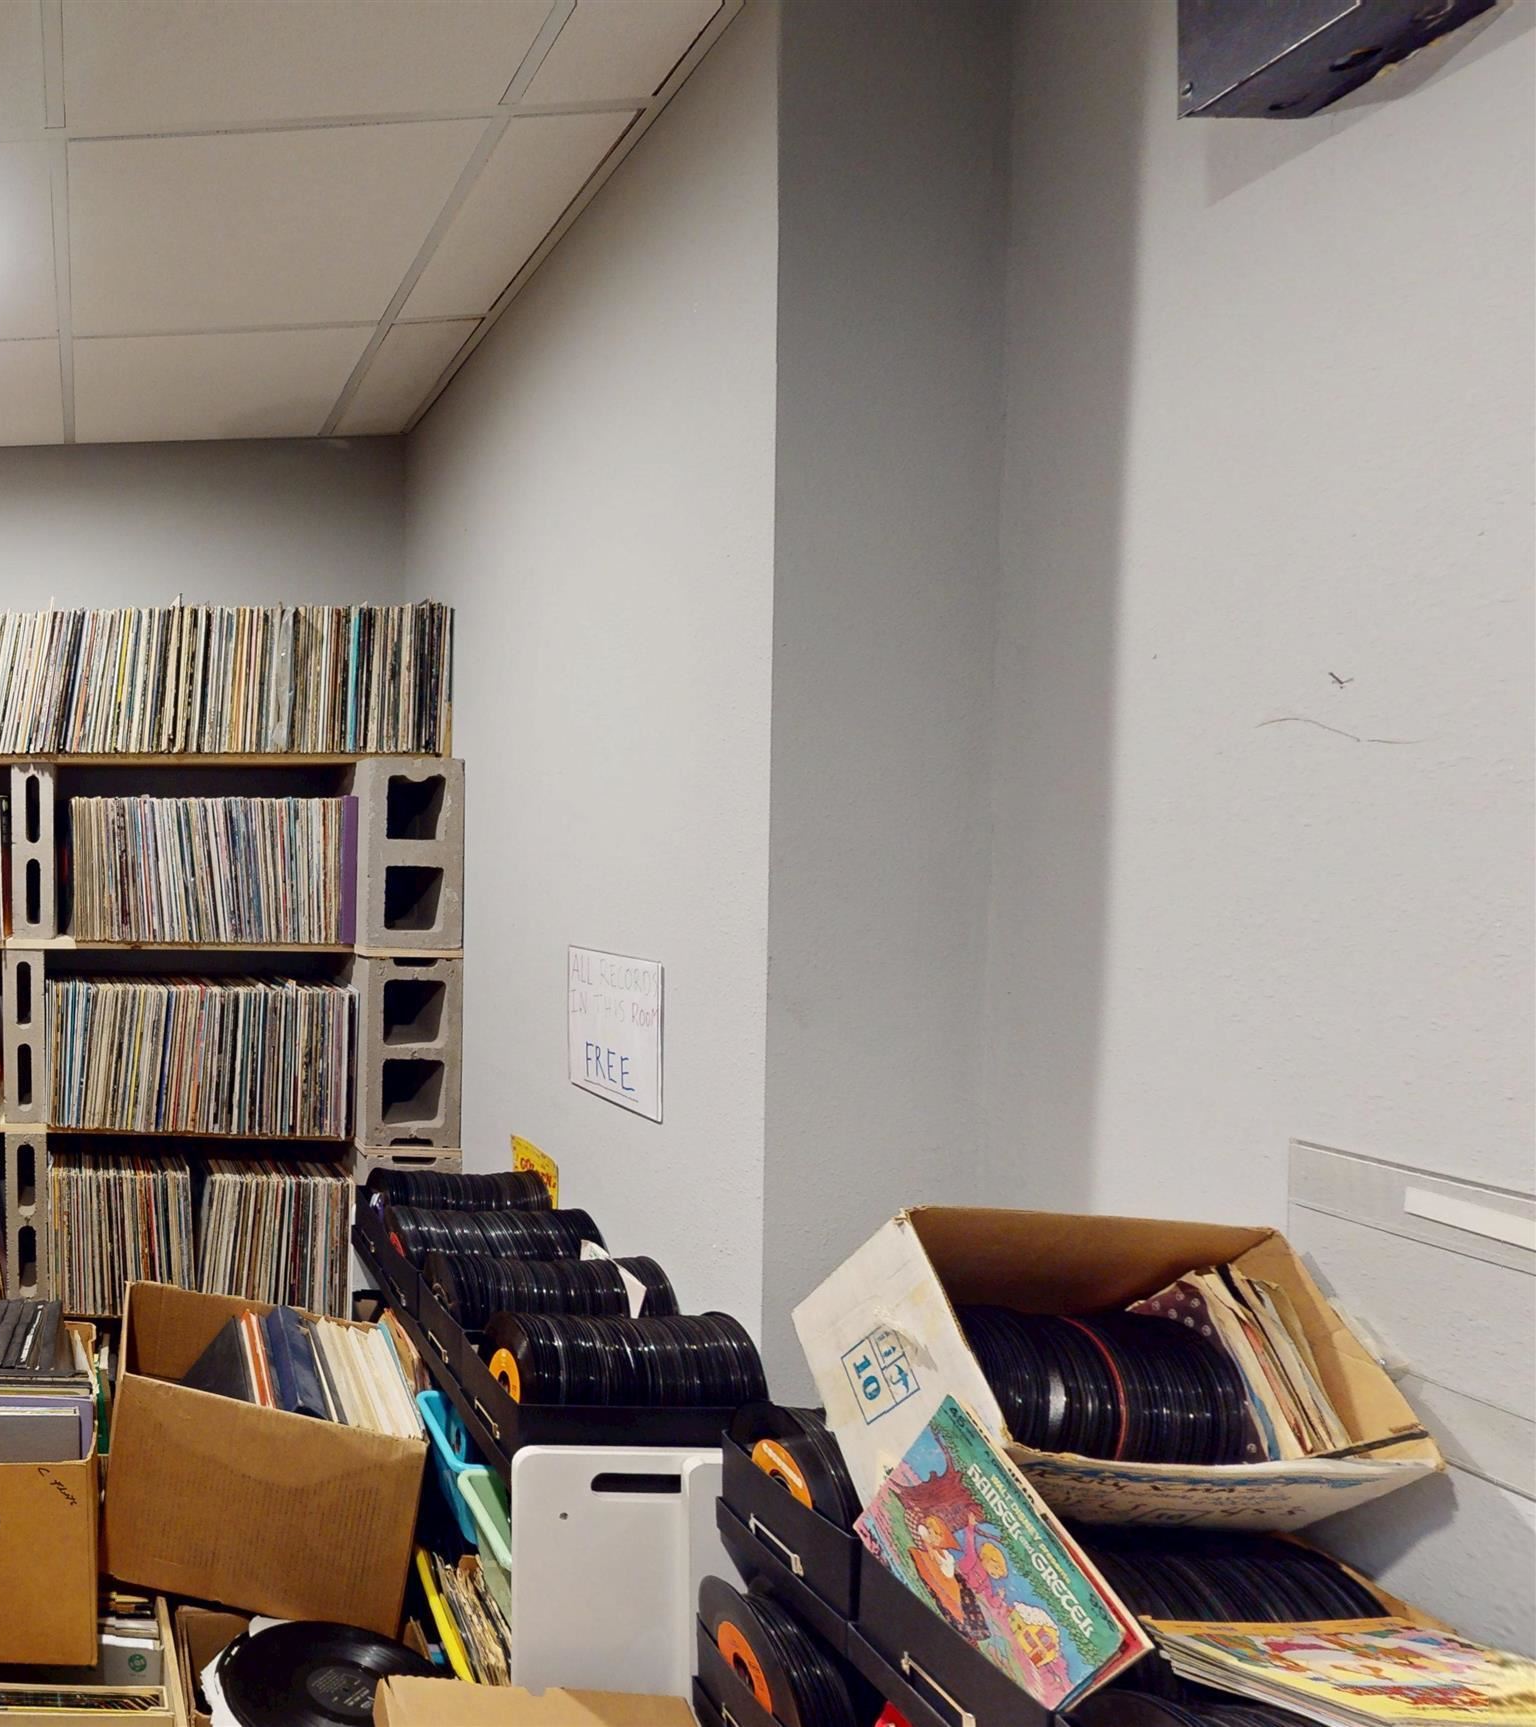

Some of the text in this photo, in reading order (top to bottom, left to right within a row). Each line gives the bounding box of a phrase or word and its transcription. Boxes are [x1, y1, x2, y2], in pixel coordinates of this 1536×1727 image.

[571, 953, 658, 997] ALL RECORDS
[571, 988, 588, 1015] IN
[593, 993, 625, 1023] THIS
[585, 1041, 635, 1092] FREE
[852, 1354, 882, 1401] 10
[991, 1474, 1014, 1502] WALT
[1011, 1501, 1042, 1541] DISNEY
[966, 1463, 1021, 1541] HANSEL
[1031, 1552, 1094, 1638] GRETEL
